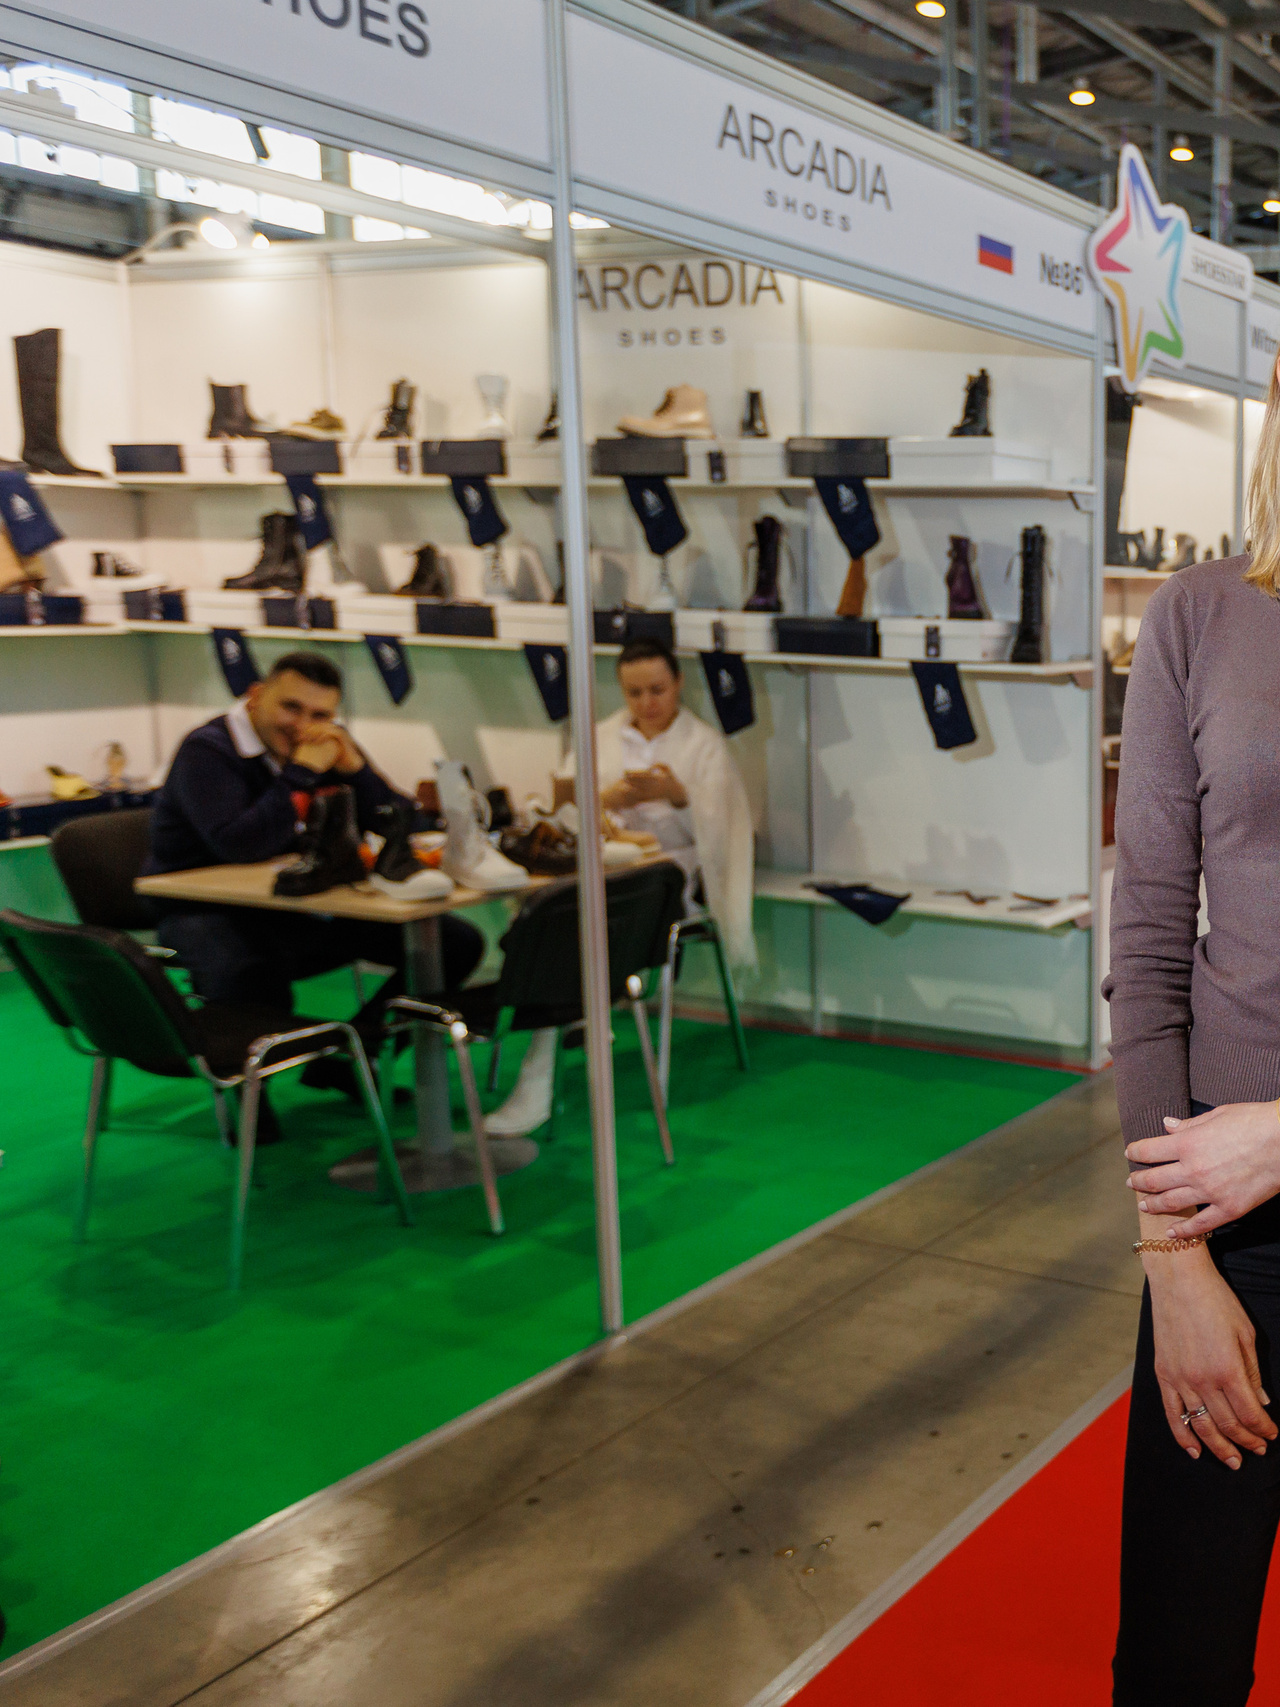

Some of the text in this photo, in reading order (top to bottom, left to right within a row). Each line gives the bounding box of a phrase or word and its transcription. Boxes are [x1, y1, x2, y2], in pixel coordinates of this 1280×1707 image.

[718, 104, 892, 211] ARCADIA
[764, 187, 852, 232] SHOES
[1040, 252, 1085, 296] №86
[618, 326, 727, 348] SHOES
